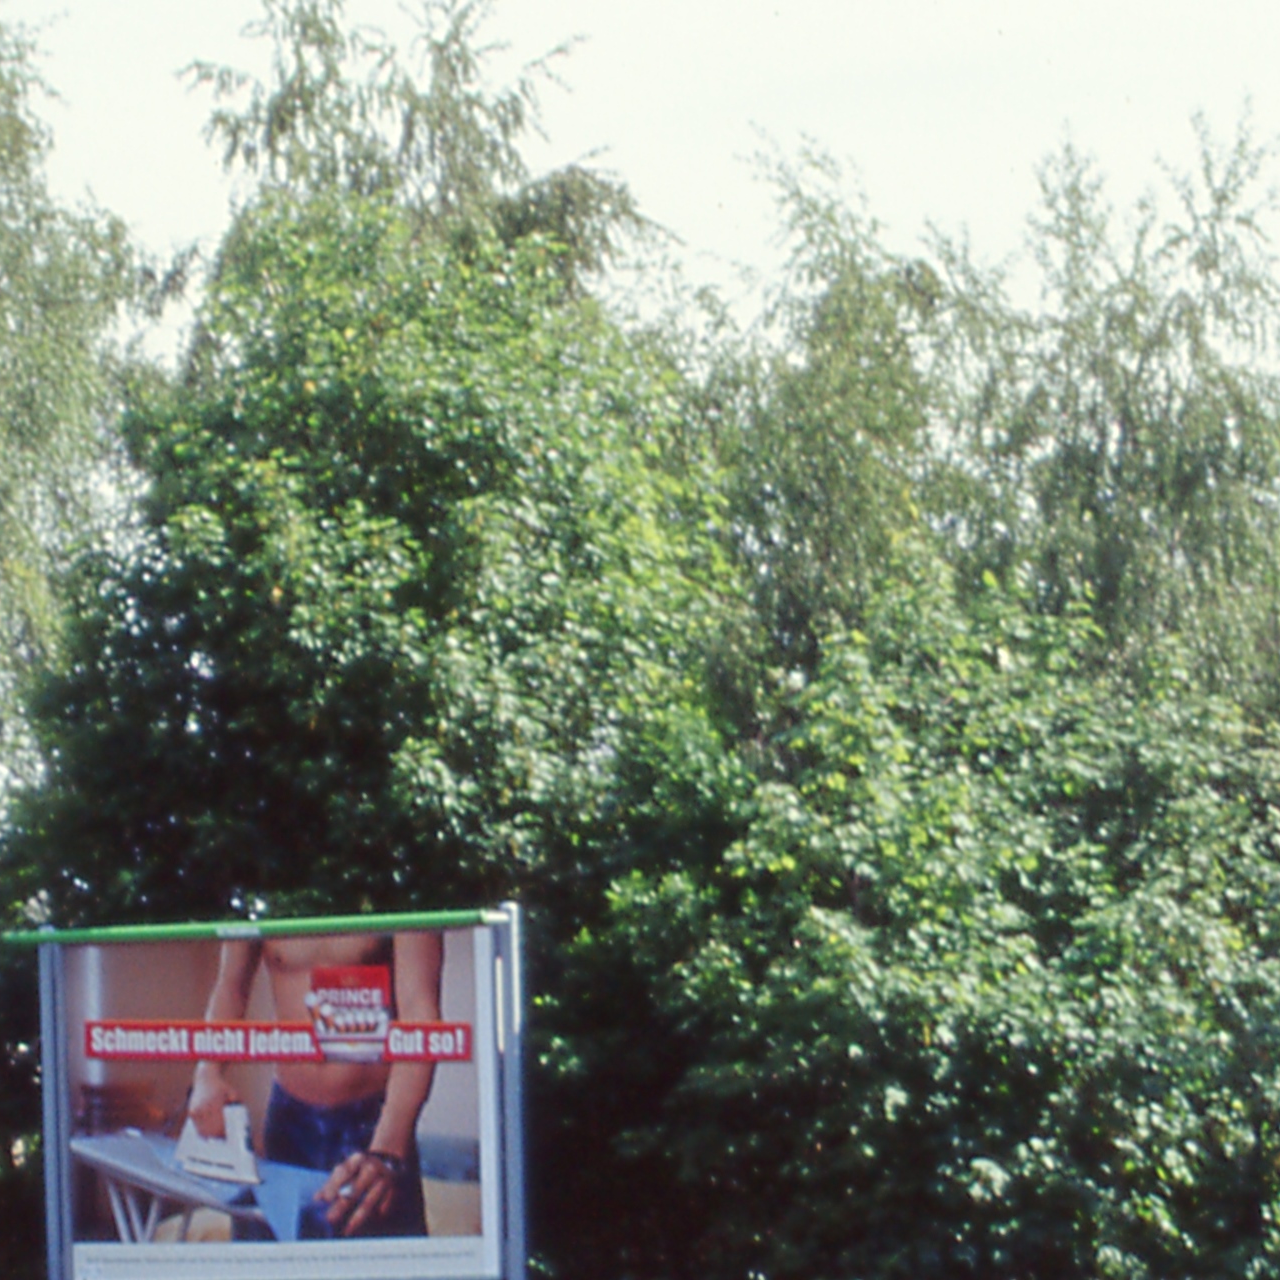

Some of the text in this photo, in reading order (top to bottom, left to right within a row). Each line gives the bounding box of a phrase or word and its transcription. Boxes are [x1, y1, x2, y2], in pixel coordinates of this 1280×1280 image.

[317, 988, 382, 1006] PRINCE
[91, 1026, 188, 1053] Schmeckt
[194, 1026, 246, 1053] nicht
[389, 1028, 423, 1054] Gut
[429, 1029, 465, 1054] so!
